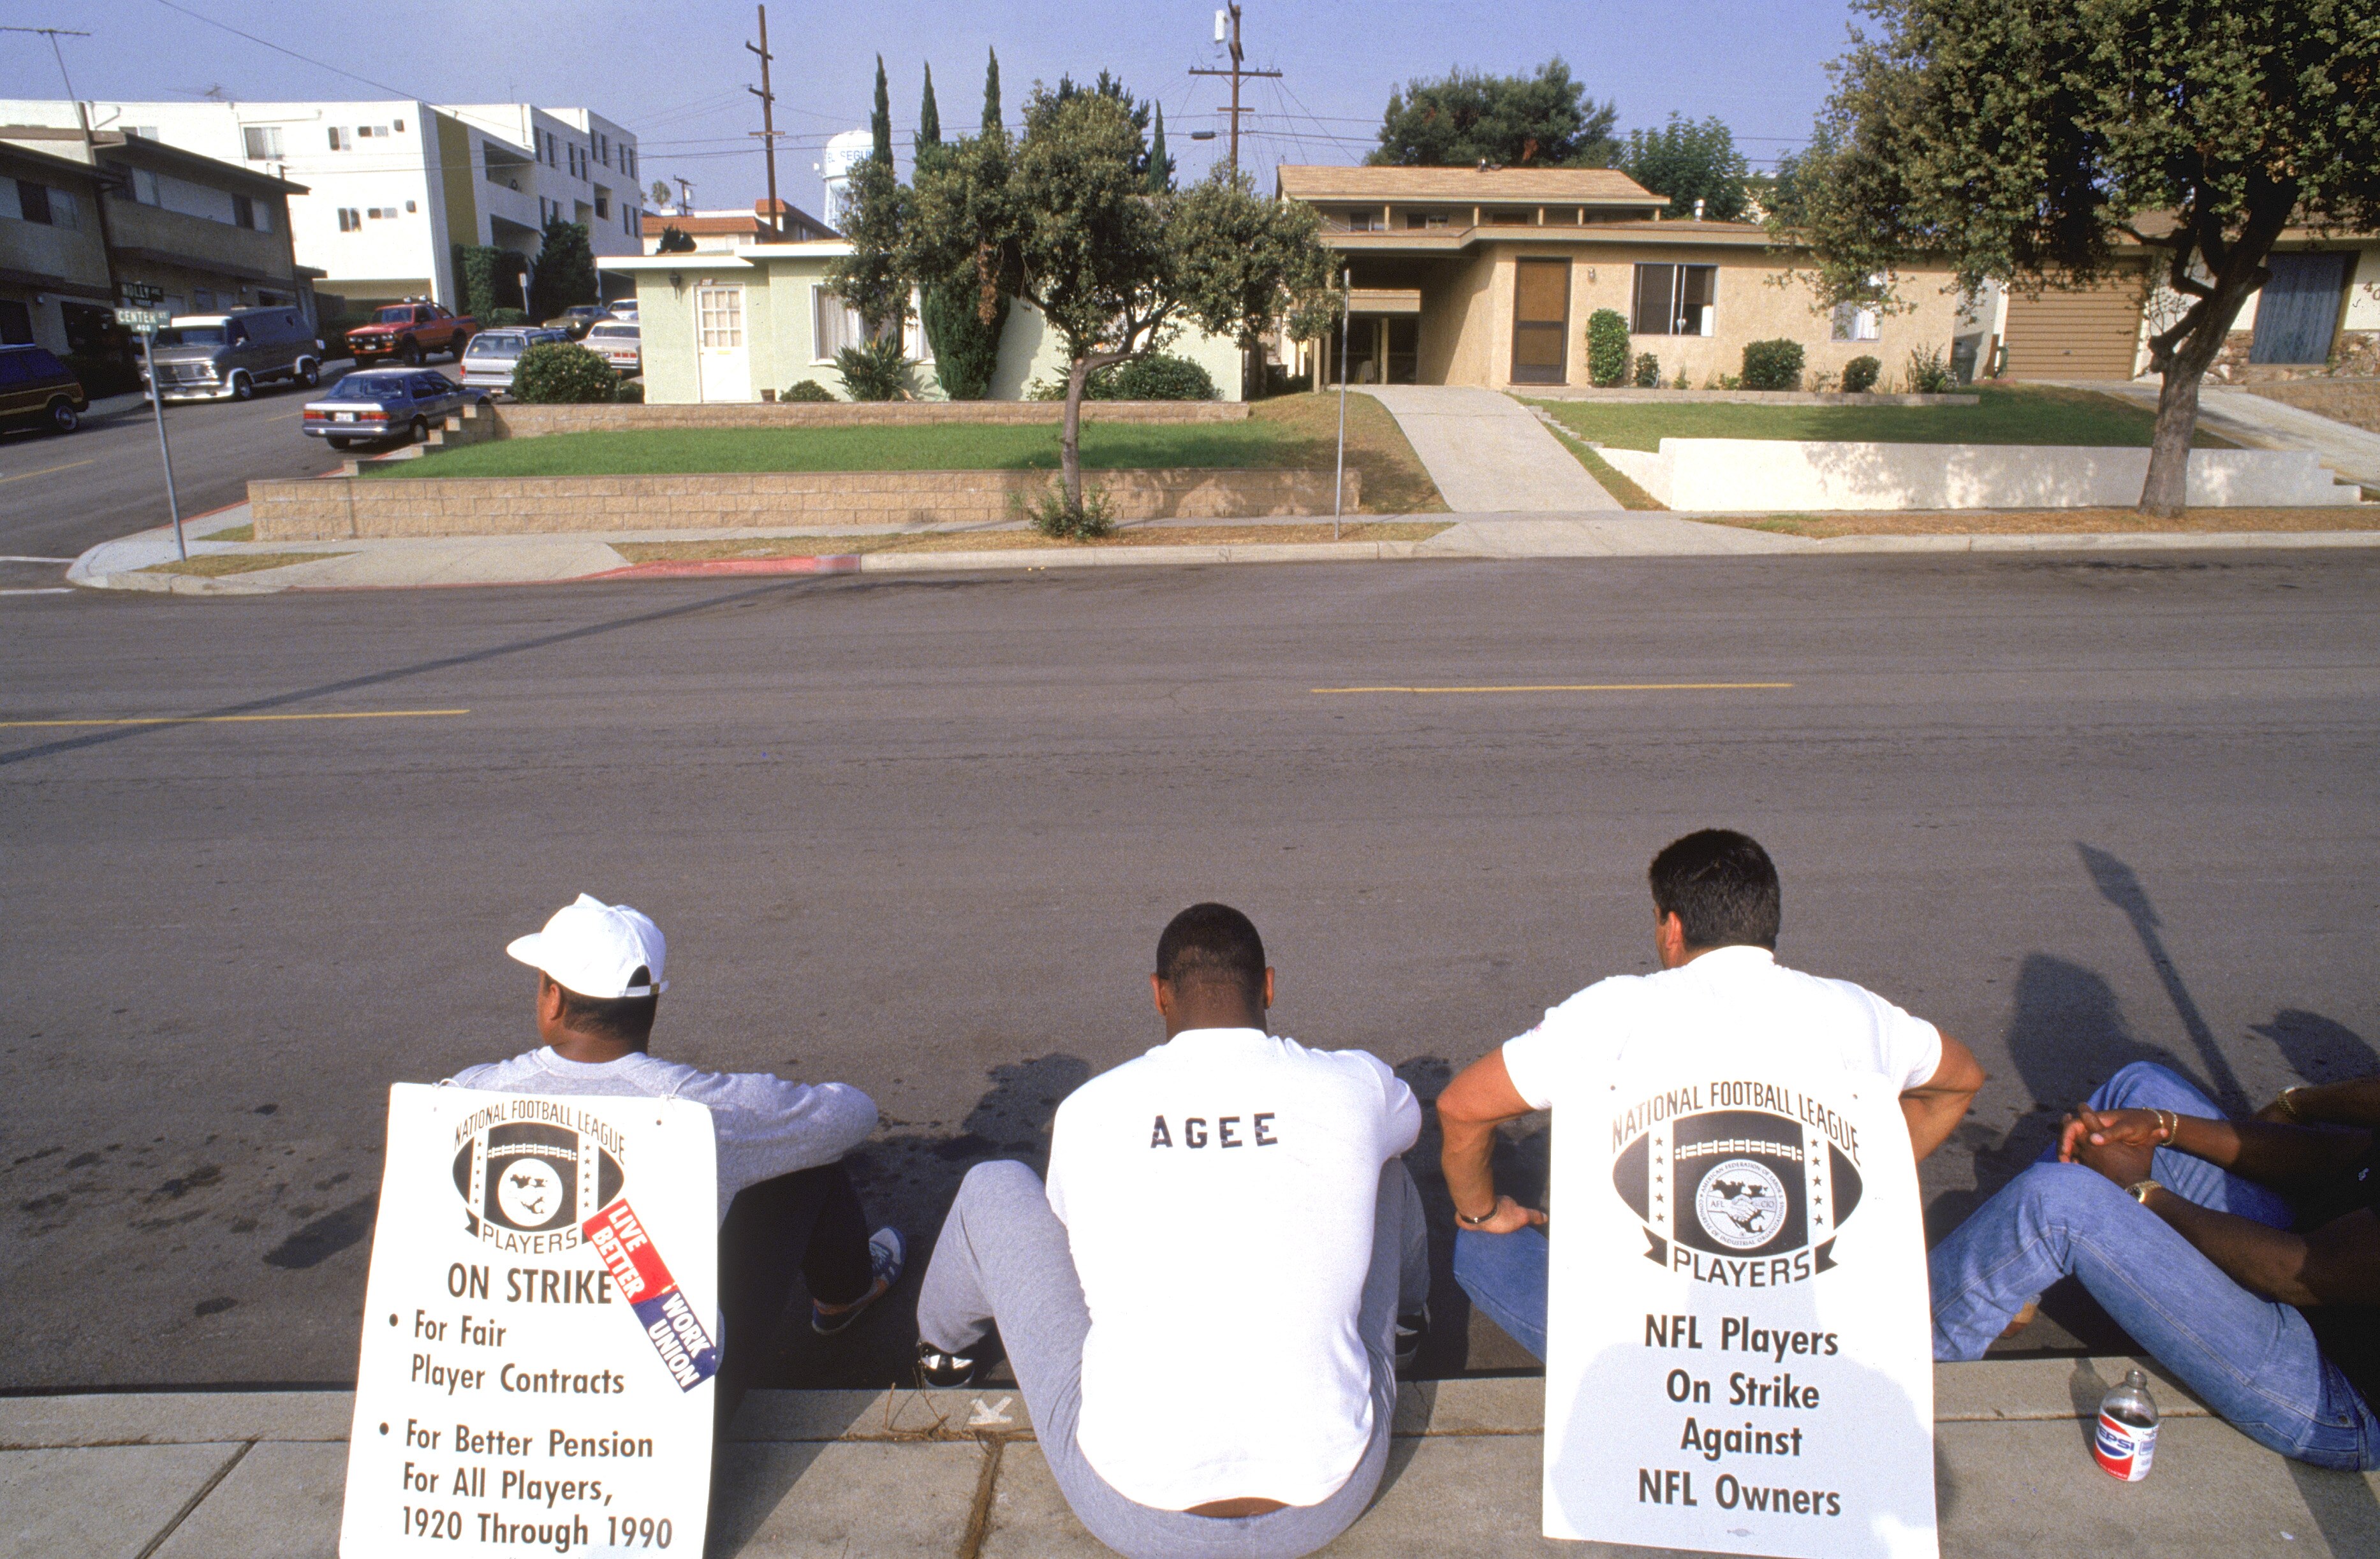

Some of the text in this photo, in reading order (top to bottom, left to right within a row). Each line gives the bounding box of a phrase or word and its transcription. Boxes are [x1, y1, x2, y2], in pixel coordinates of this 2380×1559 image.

[122, 284, 150, 298] HOLLY
[119, 311, 157, 324] CENTER
[455, 1101, 625, 1166] NATIONAL FOOTBALL LEAGUE
[1150, 1113, 1278, 1148] AGEE
[1613, 1081, 1861, 1167] NATIONAL FOOTBALL LEAGUE
[1701, 1168, 1724, 1192] AMERICAN
[1724, 1162, 1761, 1171] FEDERATION
[483, 1223, 577, 1254] PLAYERS
[608, 1205, 648, 1252] LIVE
[1699, 1199, 1712, 1230] CONGRESS
[1720, 1235, 1756, 1246] INDUSTRIAL
[1757, 1202, 1784, 1243] ORGANIZATIONS
[448, 1263, 612, 1304] ON STRIKE
[592, 1226, 645, 1299] BETTER
[1673, 1247, 1810, 1287] PLAYERS
[415, 1309, 506, 1347] For Fair
[662, 1292, 710, 1359] WORK
[1645, 1314, 1838, 1363] NFL Players
[648, 1318, 701, 1387] UNION
[412, 1354, 624, 1396] Player Contracts
[1666, 1368, 1819, 1409] On Strike
[406, 1419, 653, 1458] For Better Pension
[1680, 1417, 1803, 1461] Against
[403, 1461, 613, 1509] For All Players,
[1639, 1468, 1841, 1516] NFL Owners
[403, 1506, 673, 1553] 1920 Through 1990
